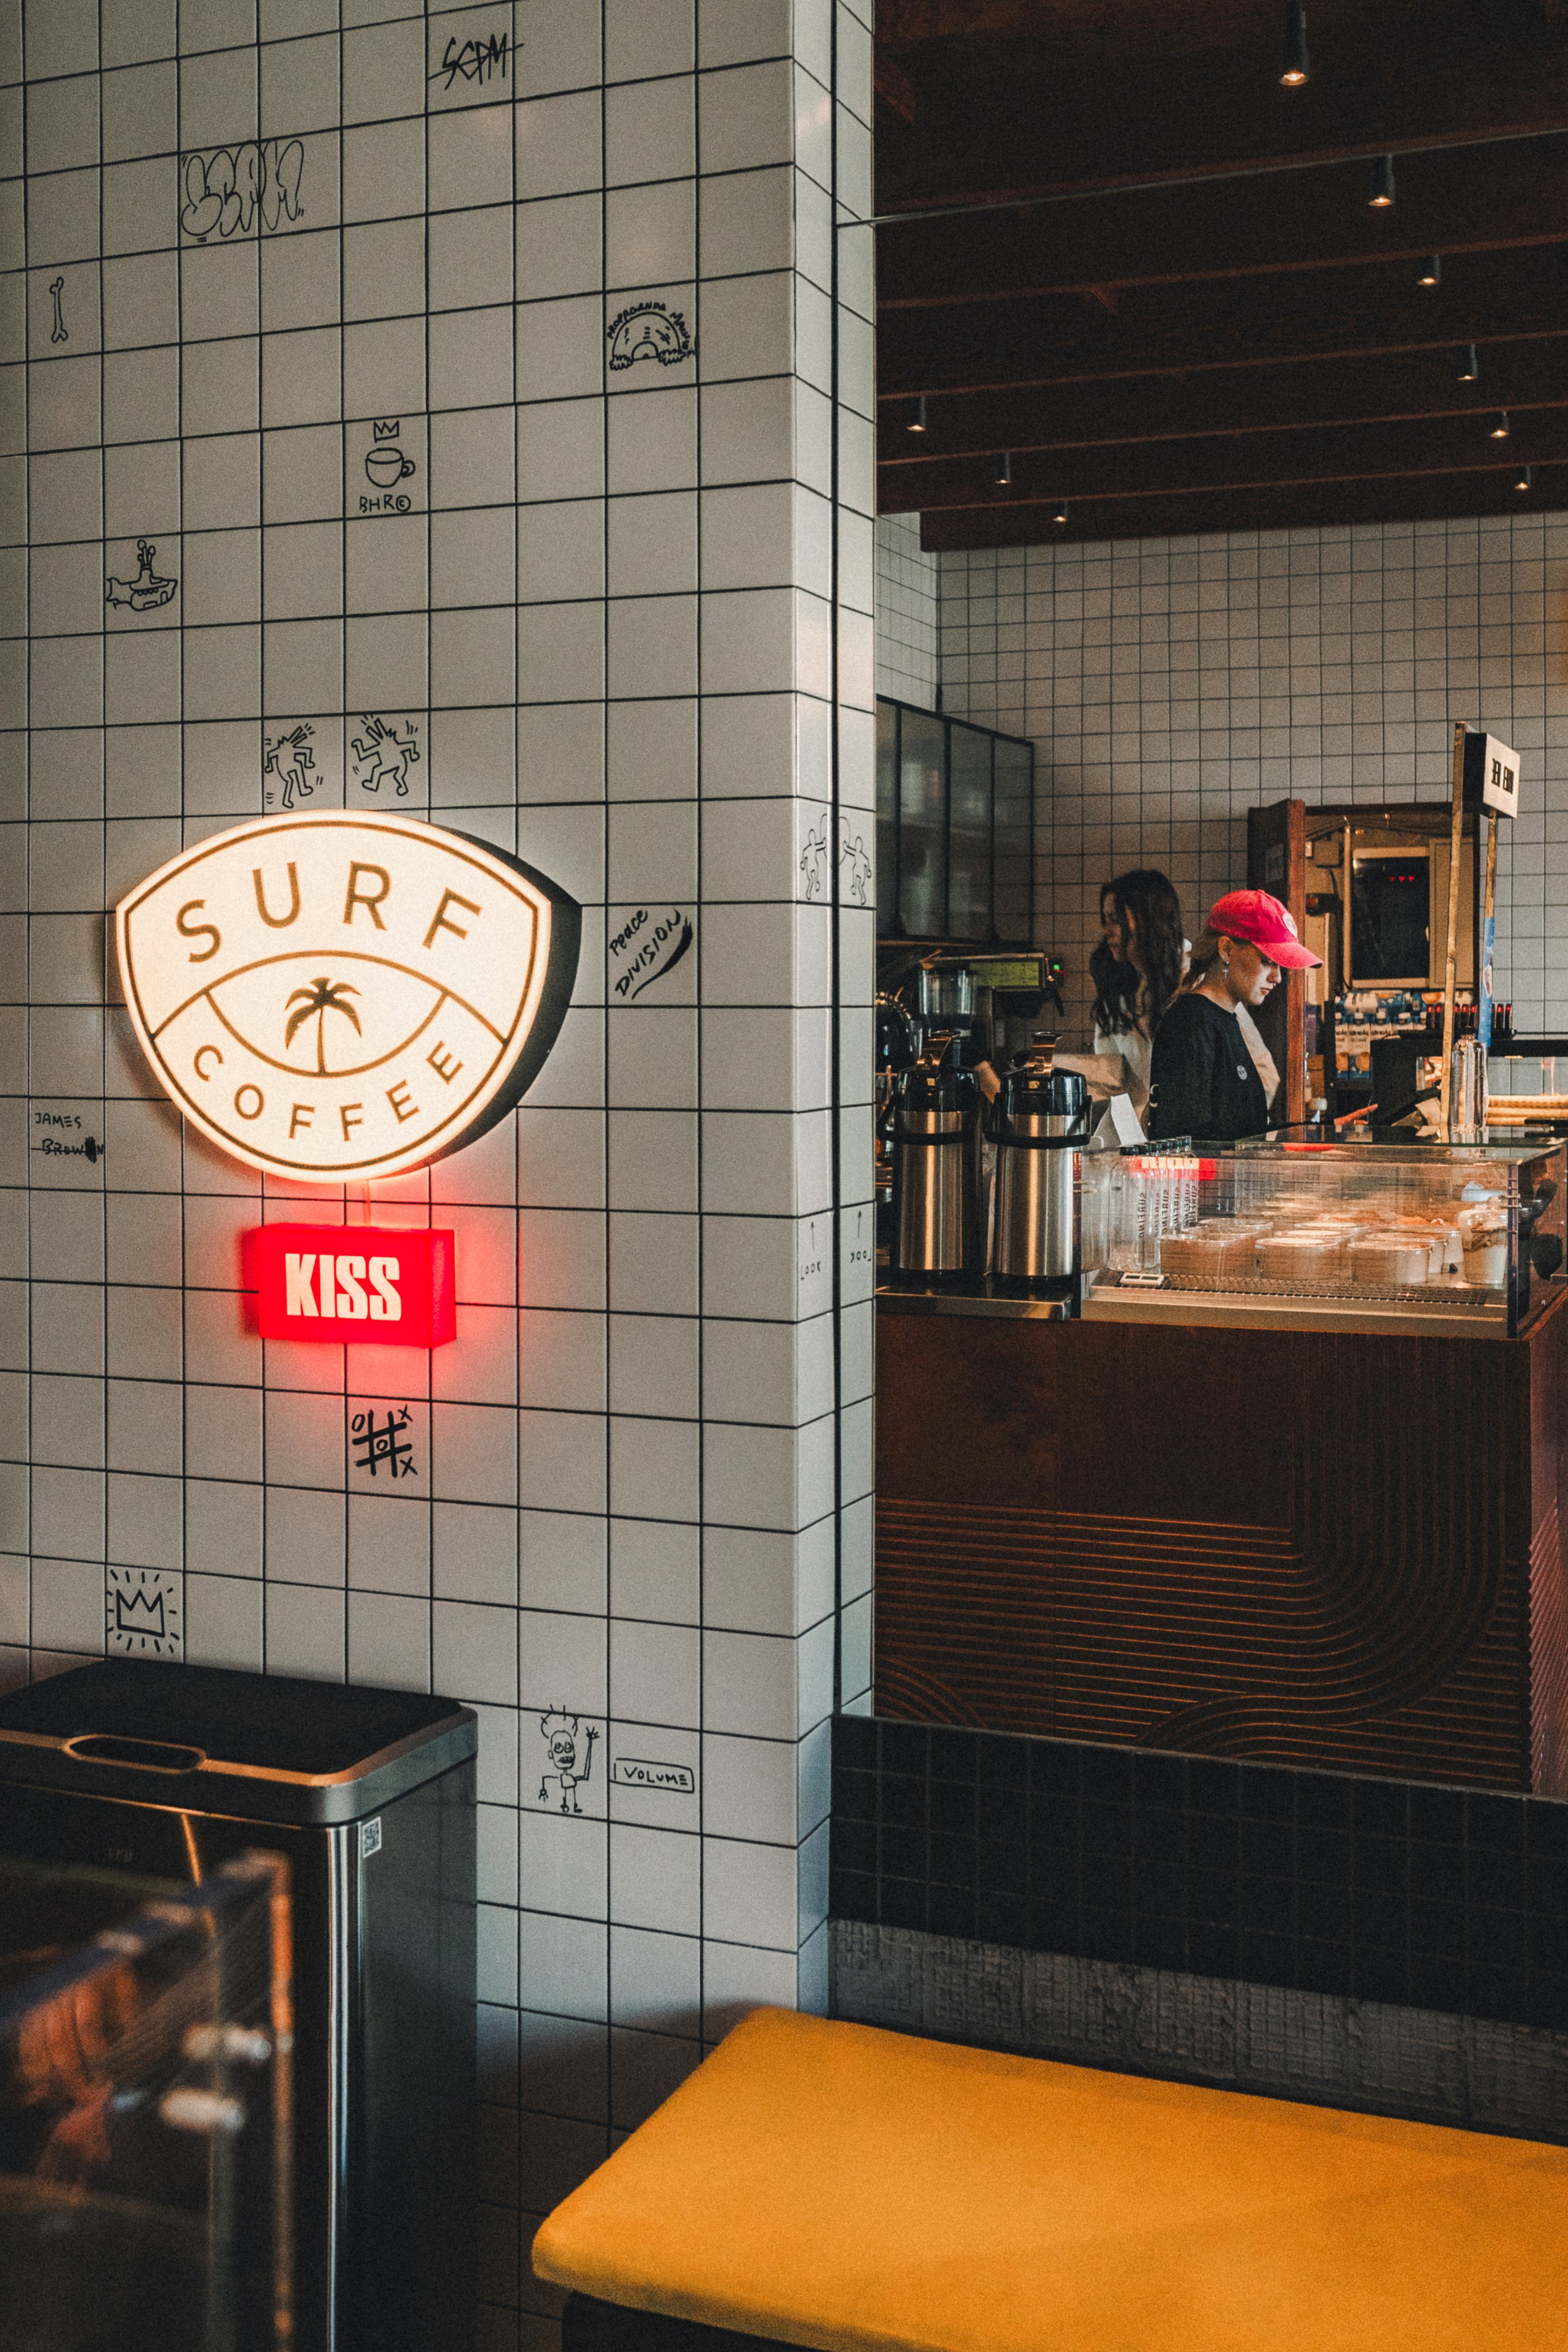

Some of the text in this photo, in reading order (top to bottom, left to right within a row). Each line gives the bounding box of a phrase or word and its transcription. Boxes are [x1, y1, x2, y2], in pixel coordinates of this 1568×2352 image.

[175, 860, 484, 963] SURF
[614, 908, 681, 997] DIVISION
[34, 1113, 81, 1129] JAMES
[193, 1040, 465, 1142] COFFEE
[285, 1253, 402, 1322] KISS
[624, 1766, 688, 1785] VOLUME
